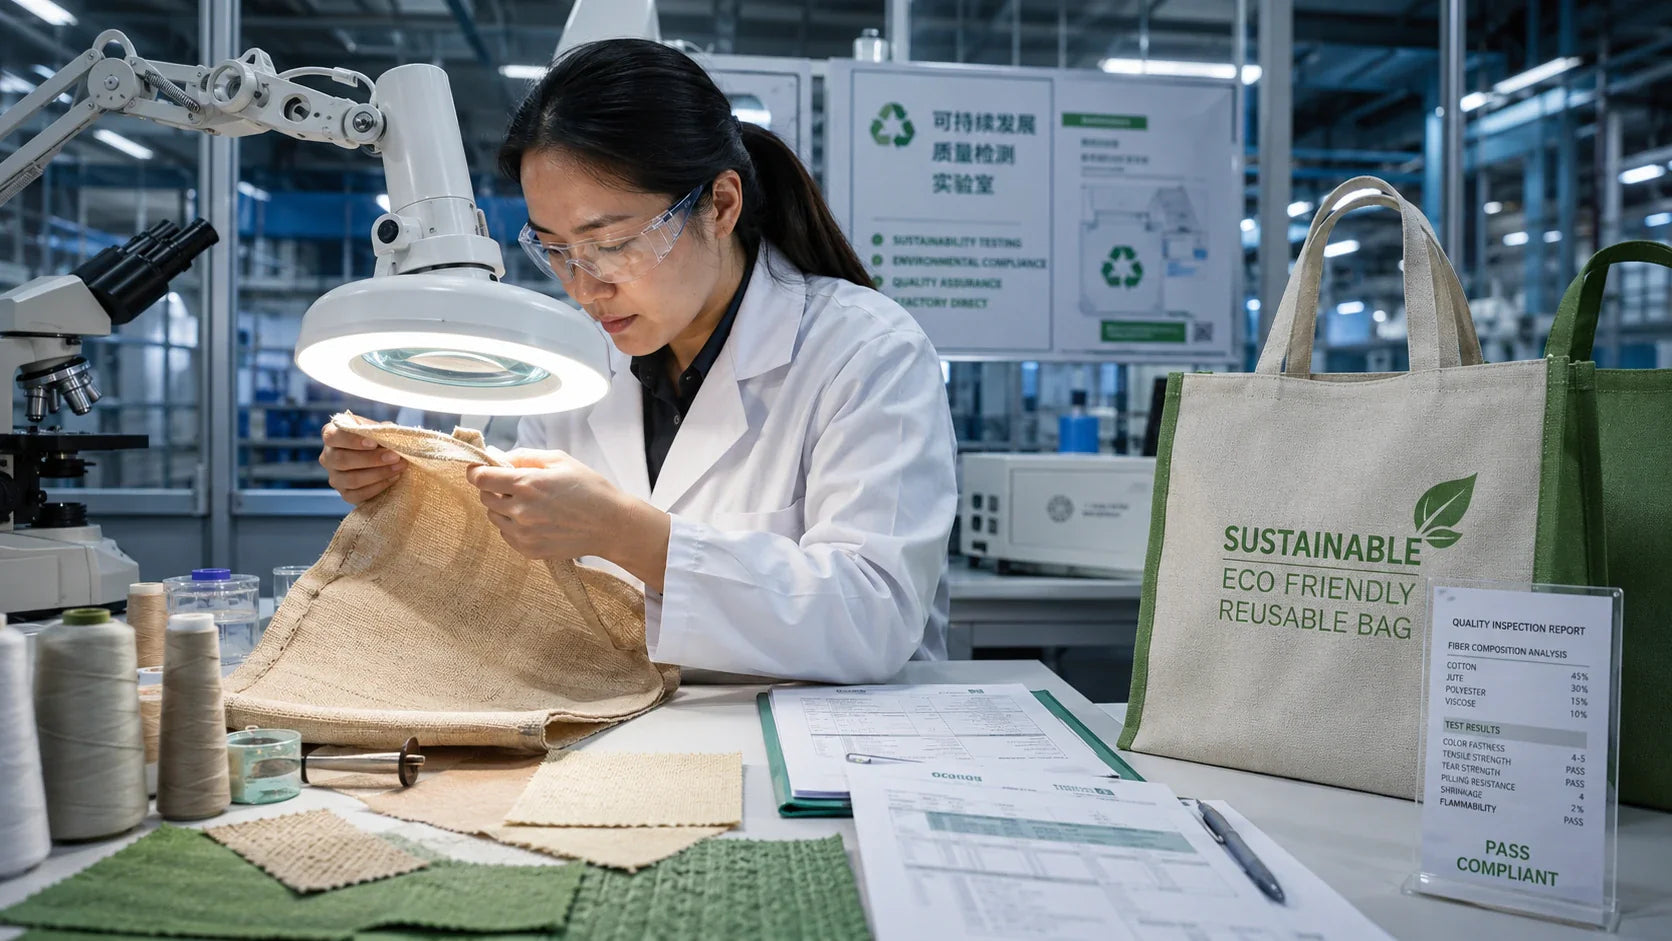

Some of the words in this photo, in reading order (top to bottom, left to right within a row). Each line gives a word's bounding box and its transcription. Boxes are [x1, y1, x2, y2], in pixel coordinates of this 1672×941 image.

[932, 110, 1036, 135] 可持续发展
[932, 142, 1015, 166] 质量检测
[932, 173, 995, 195] 实验室
[893, 235, 976, 247] SUSTAINABILITY
[979, 237, 1022, 249] TESTING
[893, 255, 979, 268] ENVIRONMENTAL
[982, 257, 1047, 269] COMPLIANCE
[893, 277, 937, 289] QUALITY
[940, 278, 1003, 290] ASSURANCE
[951, 298, 988, 309] DIRECT
[1223, 525, 1422, 566] SUSTAINABLE
[1222, 567, 1275, 593] ECO
[1284, 572, 1416, 606] FRIENDLY
[1219, 599, 1349, 634] REUSABLE
[1357, 613, 1412, 640] BAG
[1452, 618, 1491, 629] QUALITY
[1492, 621, 1546, 633] INSPECTION
[1549, 625, 1586, 636] REPORT
[1448, 642, 1470, 651] FIBER
[1471, 644, 1527, 656] COMPOSITION
[1528, 648, 1567, 659] ANALYSIS
[1447, 661, 1477, 671] COTTON
[1446, 674, 1464, 682] JUTE
[1571, 672, 1589, 681] 45%
[1445, 685, 1486, 696] POLYESTER
[1571, 684, 1588, 693] 30%
[1445, 697, 1476, 708] VISCOSE
[1571, 697, 1588, 706] 15%
[1570, 710, 1587, 719] 10%
[1446, 720, 1464, 731] TEST
[1466, 723, 1500, 734] RESULTS
[1442, 738, 1467, 748] COLOR
[1469, 741, 1505, 753] FASTNESS
[1443, 750, 1471, 761] TENSILE
[1472, 753, 1512, 766] STRENGTH
[1571, 754, 1585, 763] 4-5
[1442, 762, 1460, 772] TEAR
[1461, 764, 1501, 776] STRENGTH
[1565, 766, 1585, 776] PASS
[1441, 774, 1469, 785] PILLING
[1471, 778, 1516, 791] RESISTANCE
[1565, 779, 1585, 788] PASS
[1440, 786, 1483, 799] SHRINKAGE
[1440, 798, 1497, 813] FLAMMABILITY
[1571, 804, 1584, 813] 2%
[1563, 816, 1584, 827] PASS
[1485, 840, 1530, 861] PASS
[1457, 857, 1559, 887] COMPLIANT
